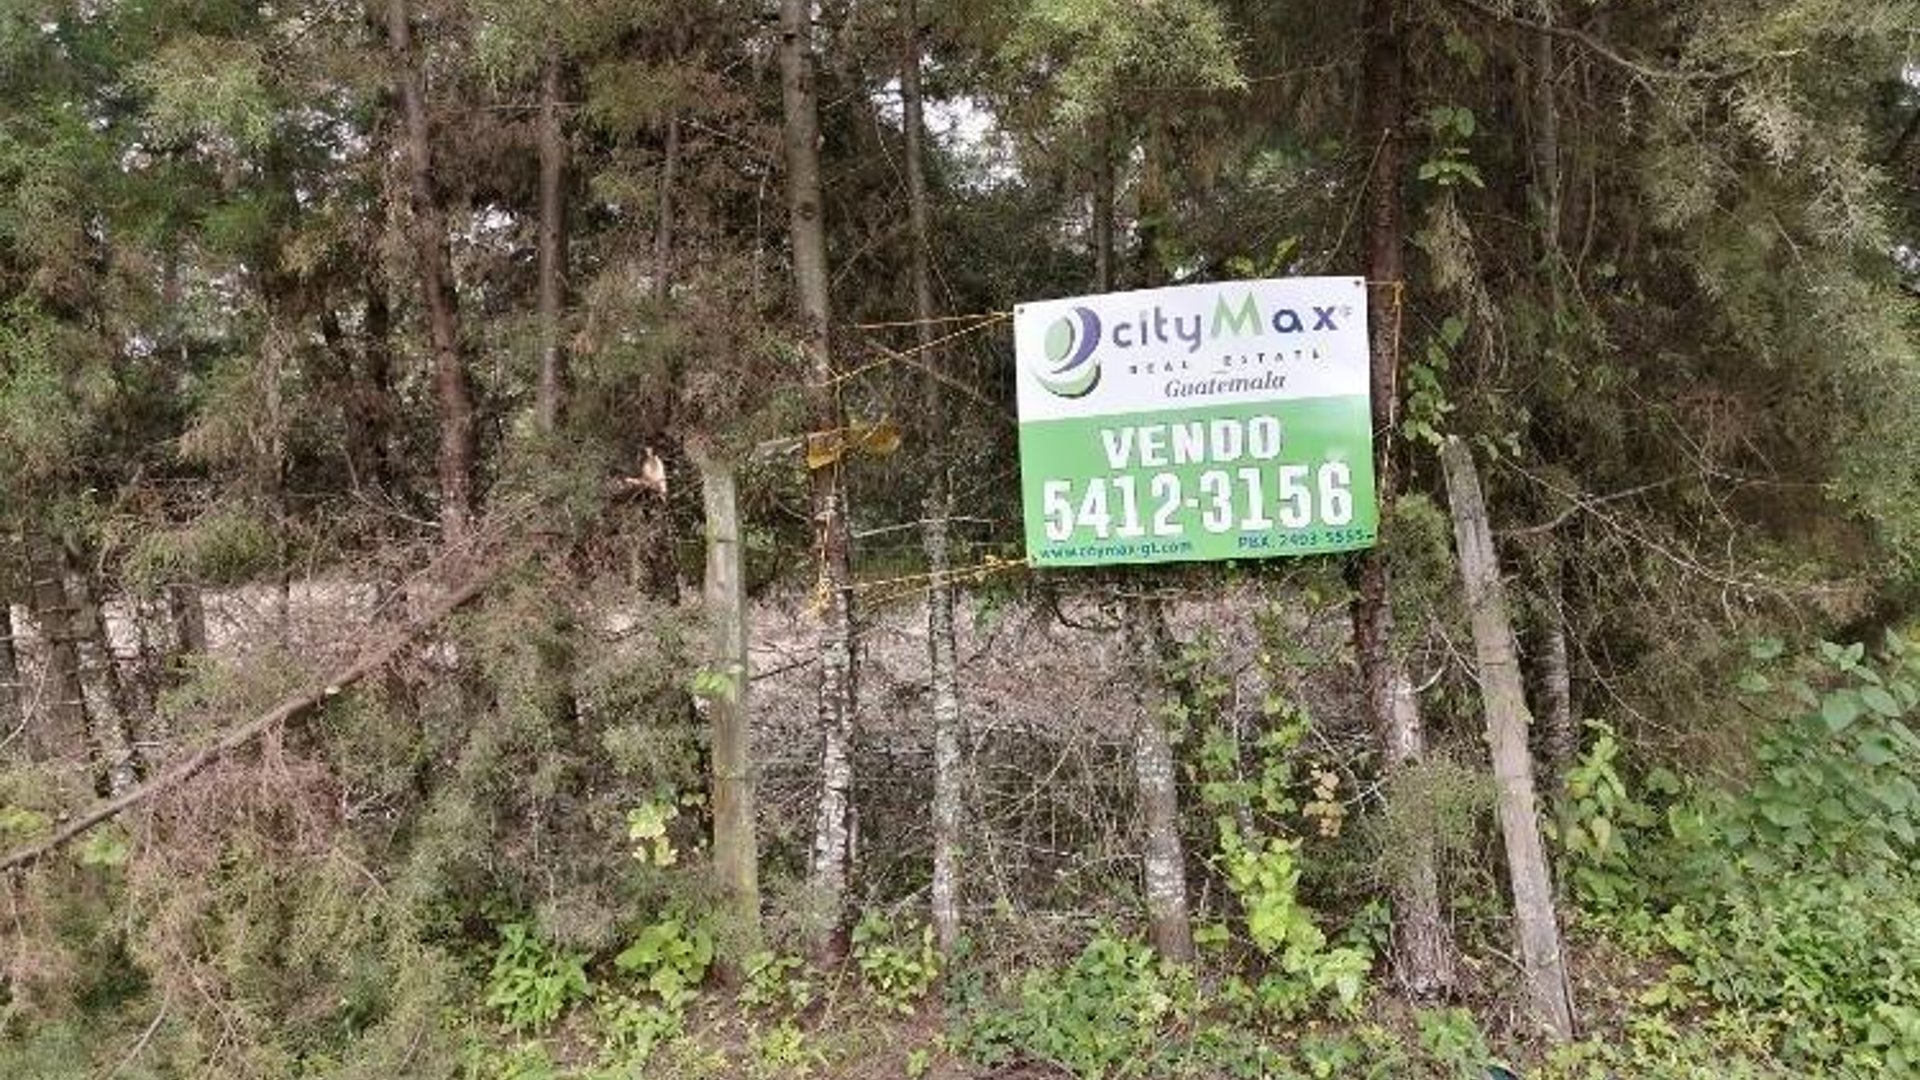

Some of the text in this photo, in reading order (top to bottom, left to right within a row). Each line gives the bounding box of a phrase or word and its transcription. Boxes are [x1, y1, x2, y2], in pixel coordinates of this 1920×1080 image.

[1130, 349, 1320, 374] REAL ESTATE
[1164, 371, 1287, 397] Guatemala
[1101, 416, 1281, 469] VENDO
[1043, 461, 1352, 542] 5412-3156
